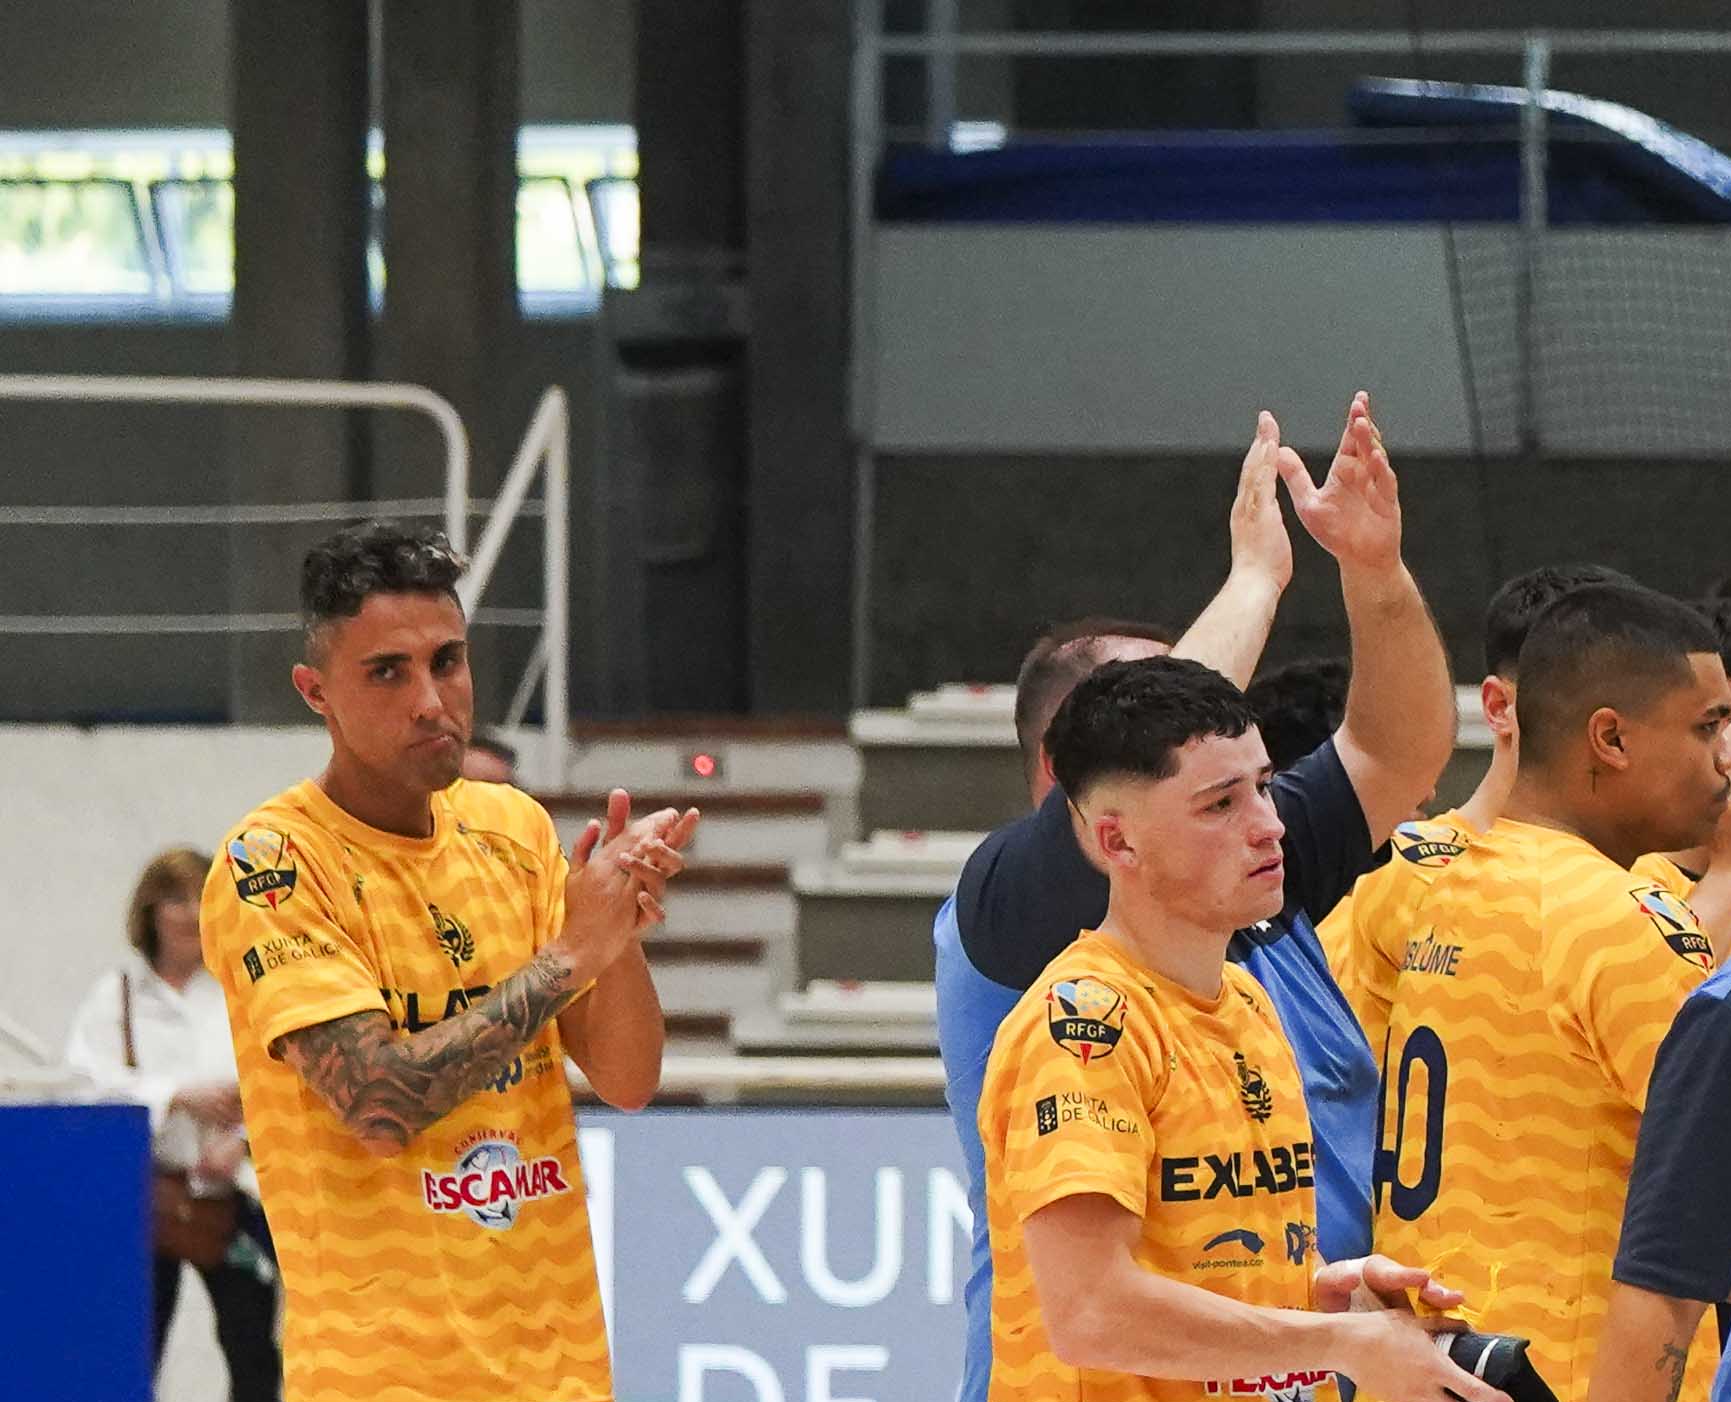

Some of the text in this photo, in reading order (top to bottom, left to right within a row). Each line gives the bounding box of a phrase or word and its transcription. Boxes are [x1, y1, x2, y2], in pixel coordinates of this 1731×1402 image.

[1065, 1021, 1107, 1039] RFGF
[1062, 1107, 1083, 1123] DE
[1161, 1142, 1316, 1202] EXLABE
[682, 1166, 975, 1307] XUN
